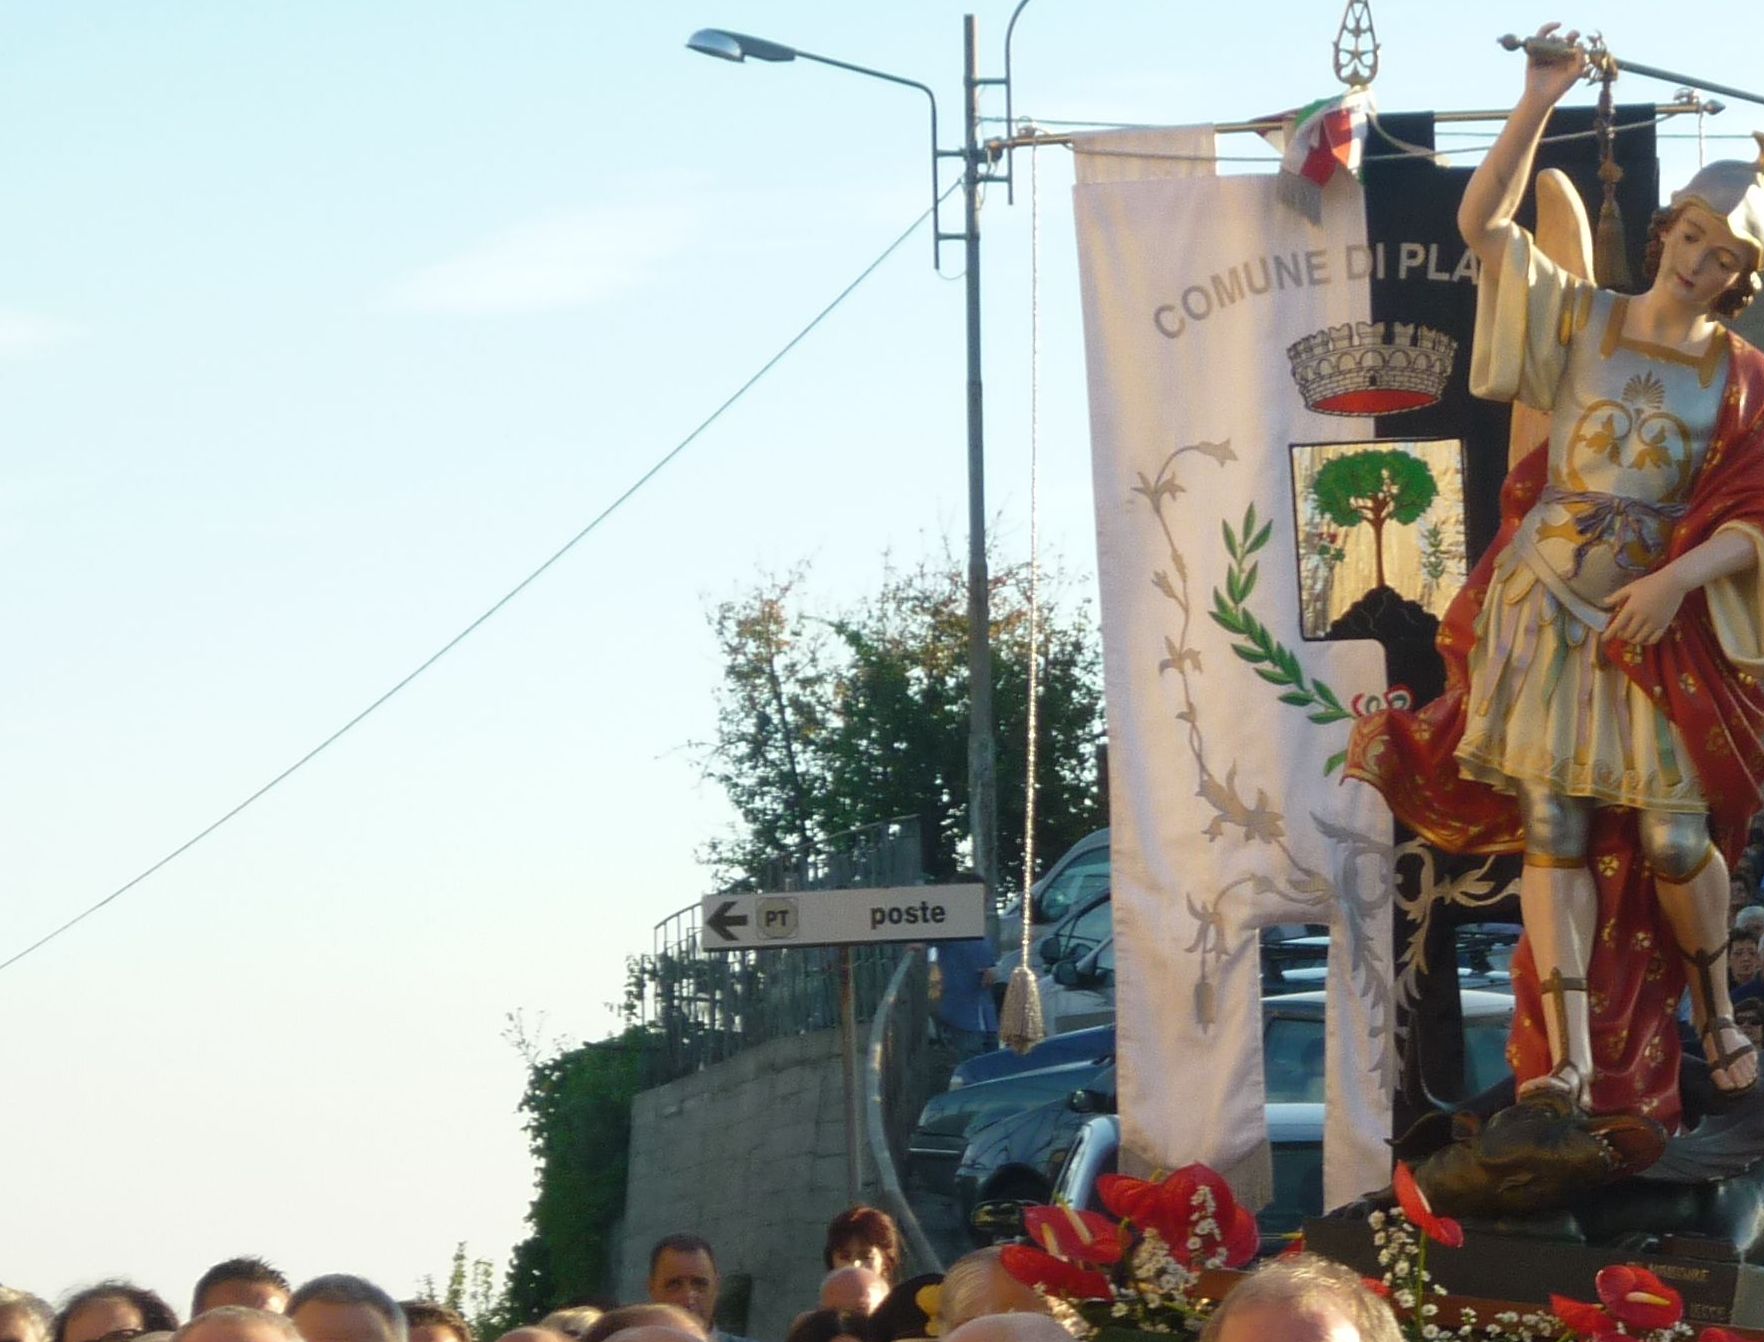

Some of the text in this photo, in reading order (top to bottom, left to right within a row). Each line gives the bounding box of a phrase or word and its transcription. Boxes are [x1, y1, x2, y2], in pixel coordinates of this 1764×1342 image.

[1154, 249, 1330, 338] COMUNE
[1346, 243, 1386, 280] DI
[765, 901, 946, 930] PT poste
